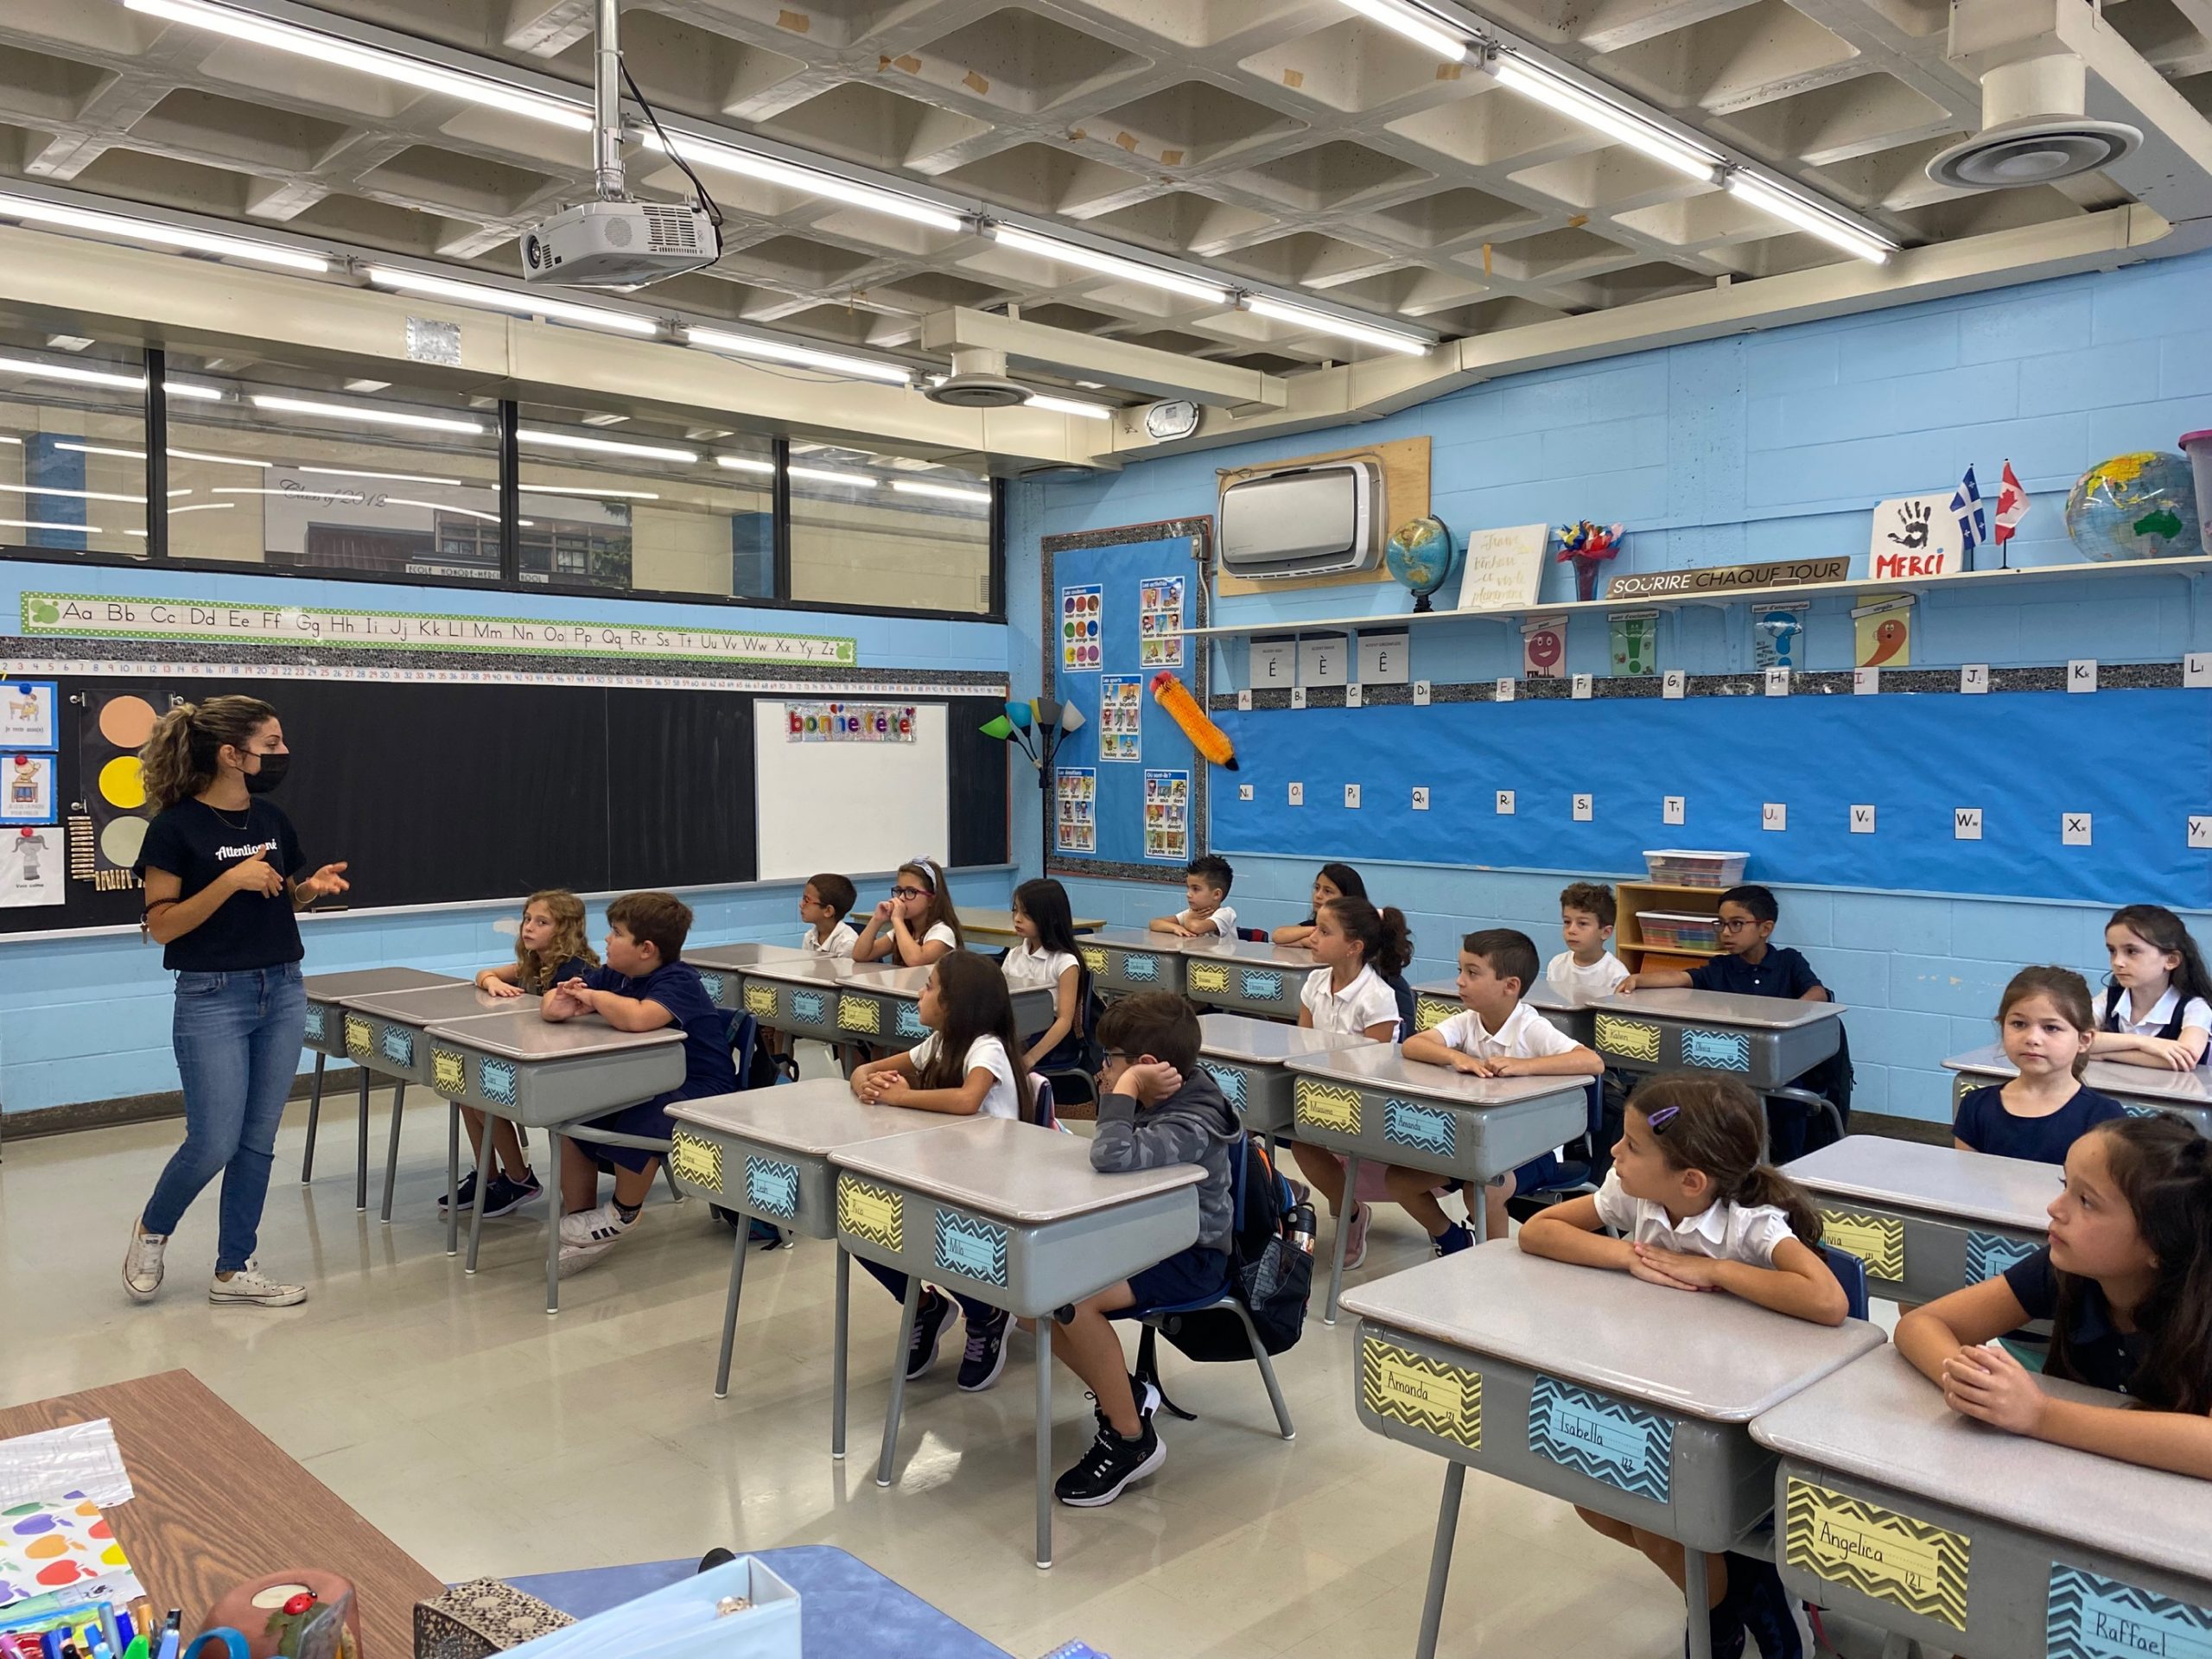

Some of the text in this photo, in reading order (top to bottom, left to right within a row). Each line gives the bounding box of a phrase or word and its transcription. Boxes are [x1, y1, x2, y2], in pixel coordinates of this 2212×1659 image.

[1696, 567, 1779, 588] CHAQUE
[1787, 563, 1841, 578] JOUR
[62, 601, 834, 658] Aa Bb Cc Dd Ee Ff Gg Hh Ii Jj Kk Ll Mm Nn Oo Pp Qq Rr Ss Tt Uu Vv Ww Xx Yy Zz
[1269, 658, 1276, 677] É
[1319, 655, 1327, 675] È
[1379, 651, 1388, 672] Ê
[789, 710, 910, 734] bonne fête
[215, 838, 278, 861] Attentioné
[1398, 1115, 1421, 1131] Amanda
[950, 1237, 964, 1255] Milo
[1821, 1230, 1842, 1246] livia
[1387, 1371, 1429, 1402] Amanda
[1445, 1411, 1456, 1421] 121
[1559, 1413, 1605, 1446] Isabella
[1621, 1456, 1635, 1471] 122
[1819, 1521, 1885, 1563] Angelica
[1904, 1571, 1923, 1590] 121
[2095, 1612, 2166, 1657] Raffael
